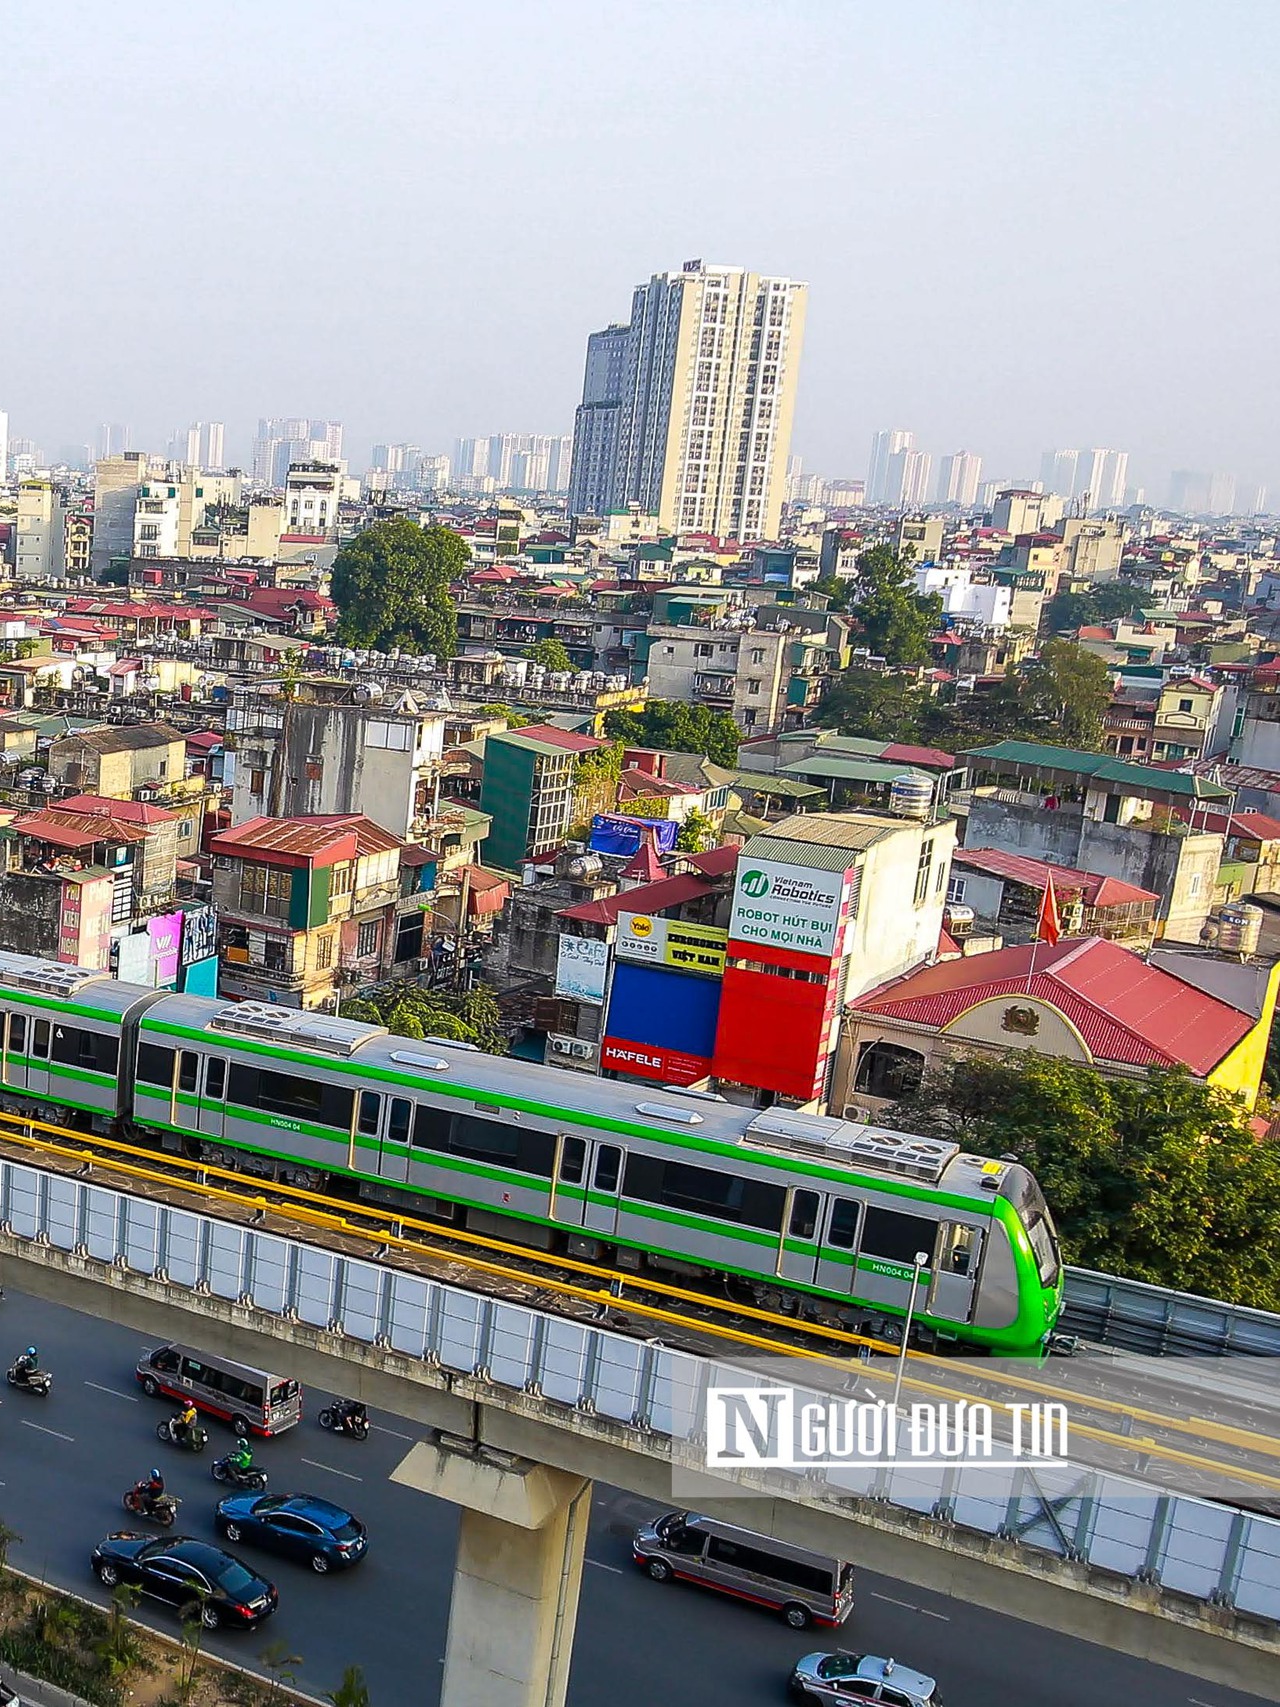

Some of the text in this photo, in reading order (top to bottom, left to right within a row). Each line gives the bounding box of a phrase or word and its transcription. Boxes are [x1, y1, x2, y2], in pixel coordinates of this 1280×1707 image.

[775, 876, 813, 888] Vietnam
[771, 884, 836, 904] Robotics
[737, 907, 833, 933] ROBOT HÚT BỤI
[741, 924, 768, 937] CHO
[771, 929, 793, 943] MỌI
[796, 934, 823, 948] NHÀ
[606, 1047, 662, 1068] HÄFELE
[872, 1263, 902, 1277] HN004
